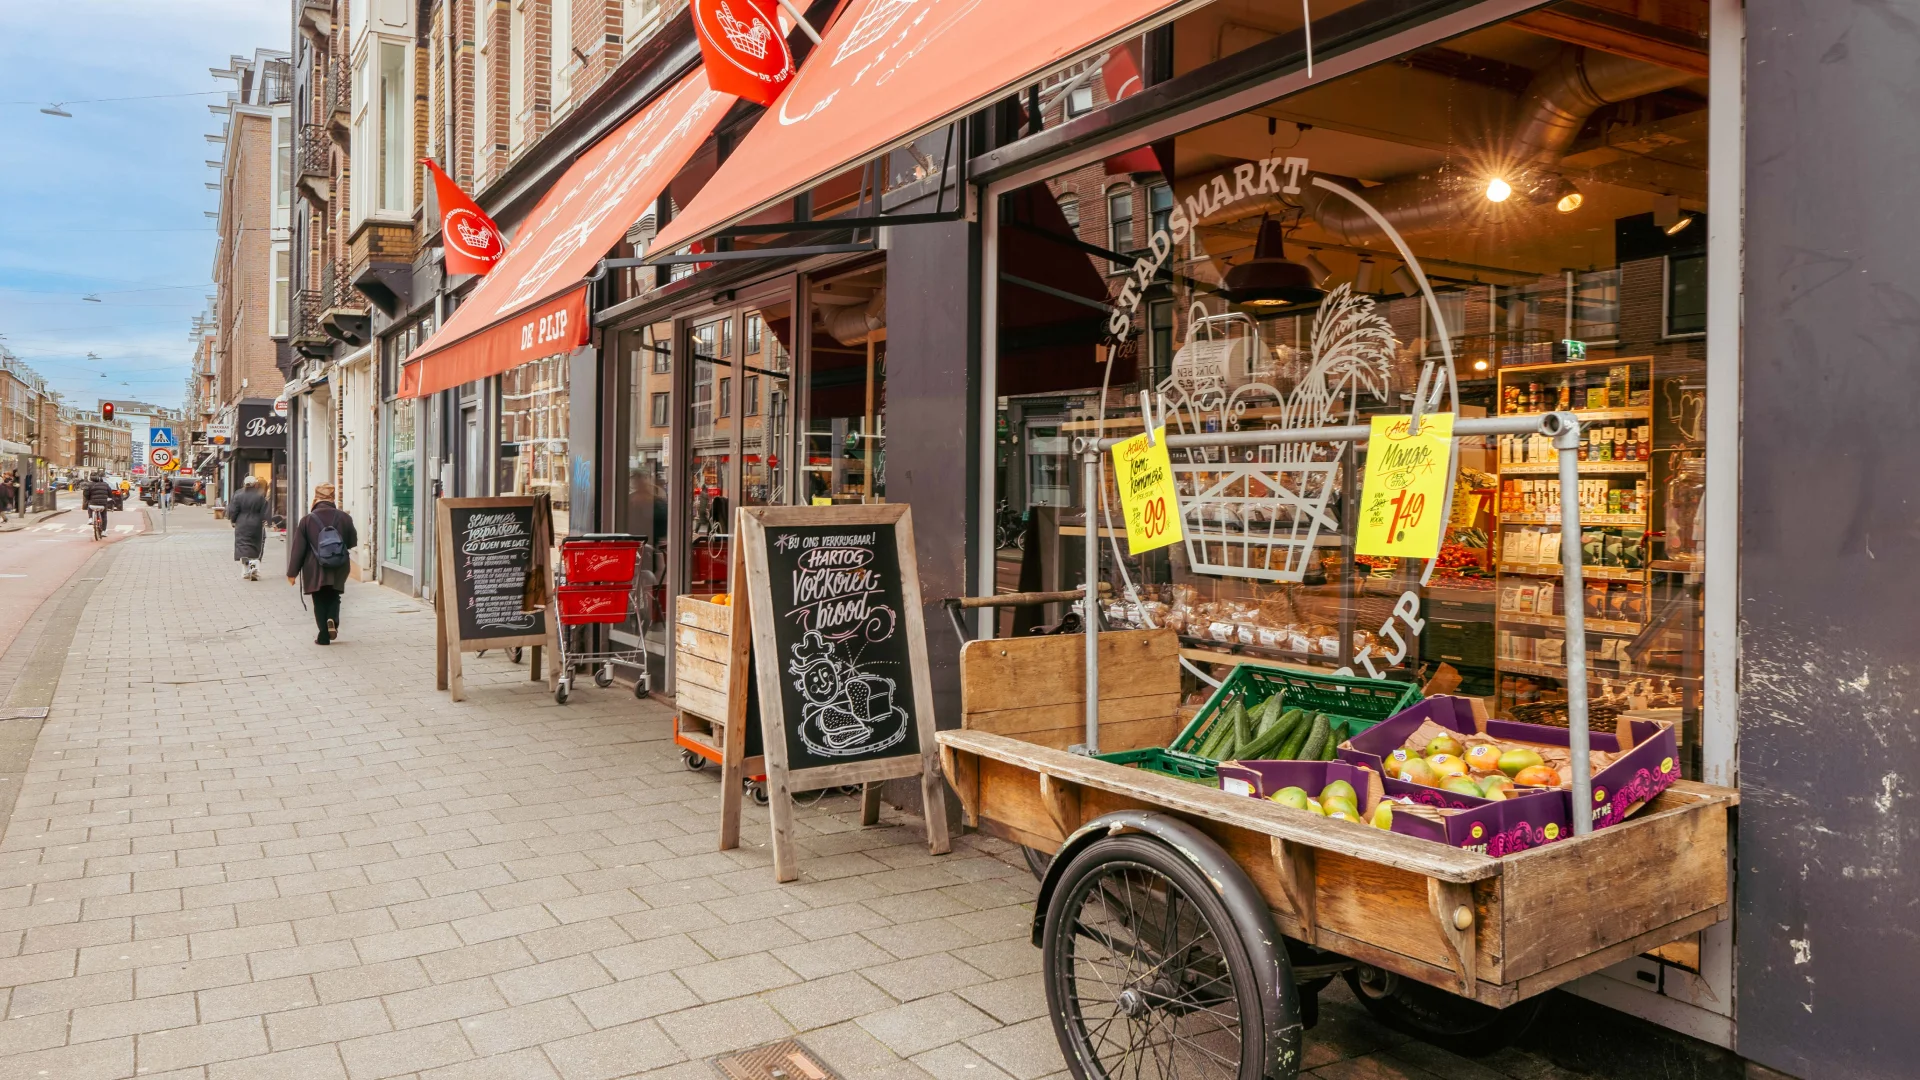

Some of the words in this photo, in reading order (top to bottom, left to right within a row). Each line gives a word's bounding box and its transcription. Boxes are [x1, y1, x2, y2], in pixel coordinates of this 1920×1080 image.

[1109, 156, 1308, 342] STADSMARKT
[520, 322, 534, 350] DE
[538, 309, 567, 344] PIJP
[155, 453, 168, 461] 30
[1378, 443, 1432, 473] Mango
[468, 512, 516, 529] Slimmer
[1145, 497, 1166, 538] 99
[466, 543, 478, 552] ZO
[480, 541, 499, 550] DOEN
[500, 540, 511, 548] WE
[788, 536, 800, 549] BIJ
[803, 537, 819, 548] ONS
[822, 532, 876, 546] VERKRIJGBAAR!
[808, 550, 864, 567] HARTOG
[816, 592, 872, 630] brood
